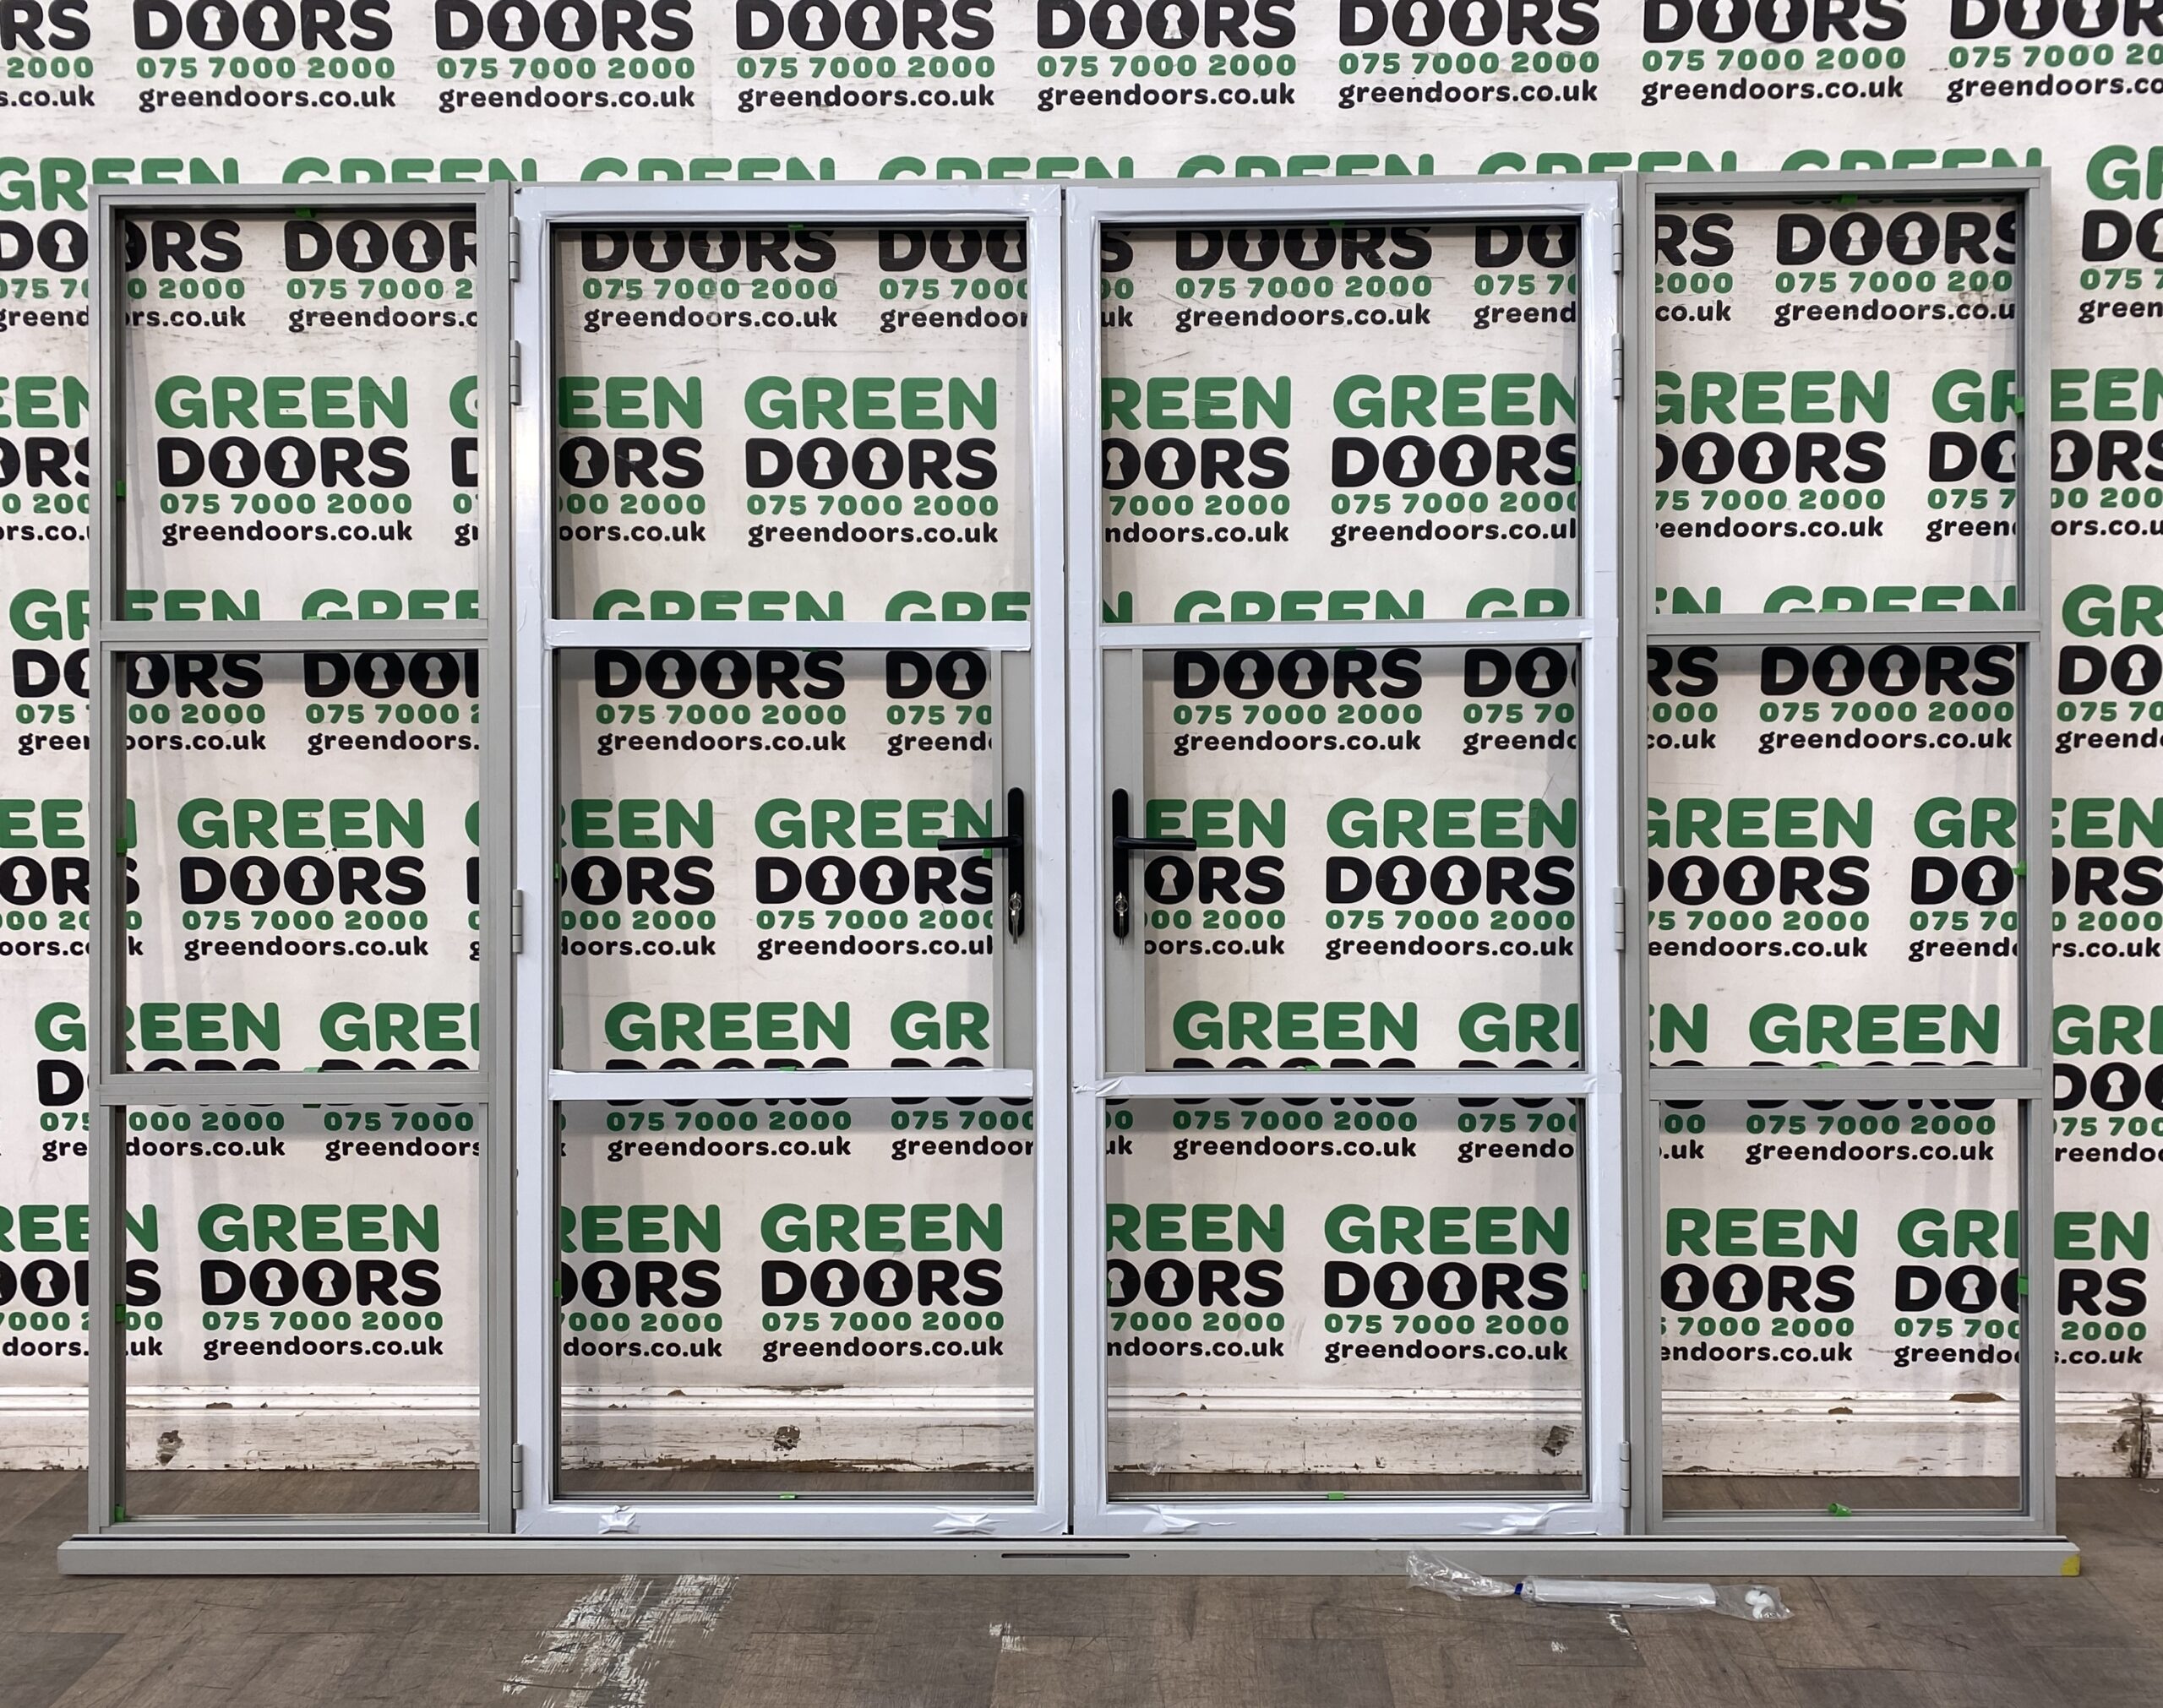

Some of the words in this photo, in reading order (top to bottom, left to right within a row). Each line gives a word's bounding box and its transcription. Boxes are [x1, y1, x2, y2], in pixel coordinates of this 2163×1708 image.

[133, 0, 392, 51] DOORS
[435, 0, 693, 52] DOORS
[736, 0, 994, 51] DOORS
[1038, 0, 1295, 49] DOORS
[1340, 0, 1599, 46] DOORS
[1644, 0, 1906, 43] DOORS
[736, 57, 798, 79] 075
[809, 56, 896, 79] 7000
[907, 56, 995, 78] 2000
[1037, 55, 1098, 77] 075
[1109, 54, 1197, 77] 7000
[1207, 53, 1296, 77] 2000
[1338, 52, 1400, 75] 075
[1411, 52, 1500, 75] 7000
[1511, 51, 1599, 73] 2000
[1642, 49, 1704, 72] 075
[1717, 48, 1804, 71] 7000
[1815, 47, 1905, 69] 2000
[1948, 46, 2010, 68] 075
[2025, 43, 2114, 68] 7000
[8, 57, 93, 79] 2000
[136, 57, 197, 79] 075
[209, 57, 295, 79] 7000
[308, 57, 395, 79] 2000
[436, 57, 498, 79] 075
[509, 57, 596, 79] 7000
[607, 57, 695, 79] 2000
[139, 85, 395, 112] greendoors.co.uk
[439, 86, 694, 112] greendoors.co.uk
[738, 84, 994, 112] greendoors.co.uk
[1038, 83, 1294, 112] greendoors.co.uk
[1339, 79, 1597, 108] greendoors.co.uk
[1642, 76, 1902, 106] greendoors.co.uk
[581, 230, 837, 272] DOORS
[1175, 229, 1432, 270] DOORS
[160, 279, 244, 299] 2000
[286, 279, 346, 299] 075
[358, 279, 444, 299] 7000
[583, 279, 641, 298] 075
[655, 279, 739, 299] 7000
[751, 279, 837, 300] 2000
[879, 279, 938, 300] 075
[1174, 277, 1234, 298] 075
[1248, 277, 1333, 298] 7000
[1345, 275, 1432, 297] 2000
[1774, 271, 1836, 293] 075
[1850, 270, 1936, 293] 7000
[585, 306, 837, 332] greendoors.co.uk
[1176, 303, 1430, 332] greendoors.co.uk
[155, 375, 408, 429] GREEN
[744, 375, 997, 430] GREEN
[157, 437, 409, 487] DOORS
[746, 438, 997, 490] DOORS
[159, 493, 219, 514] 075
[232, 493, 316, 514] 7000
[326, 493, 411, 514] 2000
[620, 493, 706, 514] 2000
[745, 495, 805, 514] 075
[817, 495, 902, 515] 7000
[913, 495, 998, 517] 2000
[1112, 495, 1194, 516] 7000
[1204, 494, 1290, 516] 2000
[1330, 493, 1391, 514] 075
[1402, 492, 1488, 514] 7000
[1703, 489, 1787, 511] 7000
[1798, 488, 1885, 510] 2000
[162, 520, 411, 546] greendoors.co.uk
[749, 522, 997, 547] greendoors.co.uk
[595, 649, 846, 699] DOORS
[1173, 649, 1422, 699] DOORS
[1760, 645, 2014, 696] DOORS
[15, 704, 74, 724] 075
[182, 704, 264, 724] 2000
[306, 703, 362, 724] 075
[378, 704, 459, 724] 7000
[596, 704, 653, 723] 075
[667, 704, 750, 725] 7000
[761, 704, 846, 725] 2000
[1173, 705, 1231, 725] 075
[1243, 704, 1326, 725] 7000
[1337, 704, 1422, 724] 2000
[1463, 704, 1523, 724] 075
[1759, 702, 1818, 721] 075
[1833, 702, 1916, 721] 7000
[1928, 702, 2014, 721] 2000
[2057, 702, 2116, 721] 075
[597, 731, 846, 755] greendoors.co.uk
[1174, 730, 1420, 756] greendoors.co.uk
[1759, 728, 2011, 753] greendoors.co.uk
[177, 798, 424, 849] GREEN
[1327, 797, 1577, 849] GREEN
[180, 856, 426, 905] DOORS
[1327, 856, 1574, 906] DOORS
[183, 911, 240, 930] 075
[251, 910, 334, 930] 7000
[345, 910, 428, 931] 2000
[632, 910, 716, 930] 2000
[755, 910, 815, 930] 075
[825, 909, 907, 930] 7000
[1325, 909, 1384, 930] 075
[1396, 910, 1479, 931] 7000
[1490, 910, 1575, 931] 2000
[1688, 910, 1771, 931] 7000
[1783, 911, 1870, 932] 2000
[1909, 911, 1968, 931] 075
[185, 936, 428, 960] greendoors.co.uk
[1326, 935, 1573, 960] greendoors.co.uk
[605, 1001, 850, 1052] GREEN
[1173, 1001, 1417, 1052] GREEN
[1749, 1003, 1999, 1054] GREEN
[202, 1112, 284, 1131] 2000
[323, 1112, 380, 1131] 075
[394, 1112, 473, 1131] 7000
[606, 1112, 663, 1132] 075
[676, 1111, 757, 1131] 7000
[769, 1112, 851, 1131] 2000
[1172, 1111, 1230, 1129] 075
[1242, 1111, 1322, 1130] 7000
[1334, 1112, 1417, 1132] 2000
[1746, 1115, 1805, 1134] 075
[1818, 1116, 1899, 1135] 7000
[1910, 1116, 1995, 1134] 2000
[607, 1136, 851, 1161] greendoors.co.uk
[1174, 1136, 1416, 1160] greendoors.co.uk
[1746, 1140, 1993, 1164] greendoors.co.uk
[198, 1203, 439, 1252] GREEN
[760, 1203, 1003, 1253] GREEN
[1324, 1204, 1569, 1256] GREEN
[200, 1259, 441, 1306] DOORS
[762, 1259, 1002, 1307] DOORS
[1325, 1261, 1568, 1310] DOORS
[201, 1311, 258, 1330] 075
[270, 1311, 351, 1330] 7000
[362, 1311, 444, 1330] 2000
[641, 1313, 722, 1332] 2000
[761, 1313, 819, 1331] 075
[831, 1311, 911, 1332] 7000
[923, 1311, 1004, 1330] 2000
[1113, 1312, 1192, 1331] 7000
[1202, 1313, 1285, 1332] 2000
[1323, 1314, 1381, 1334] 075
[1395, 1314, 1474, 1335] 7000
[1485, 1314, 1568, 1335] 2000
[1680, 1317, 1760, 1336] 7000
[1770, 1318, 1854, 1338] 2000
[1893, 1318, 1952, 1337] 075
[2062, 1322, 2146, 1341] 2000
[204, 1336, 443, 1360] greendoors.co.uk
[763, 1336, 1003, 1362] greendoors.co.uk
[1325, 1340, 1567, 1363] greendoors.co.uk
